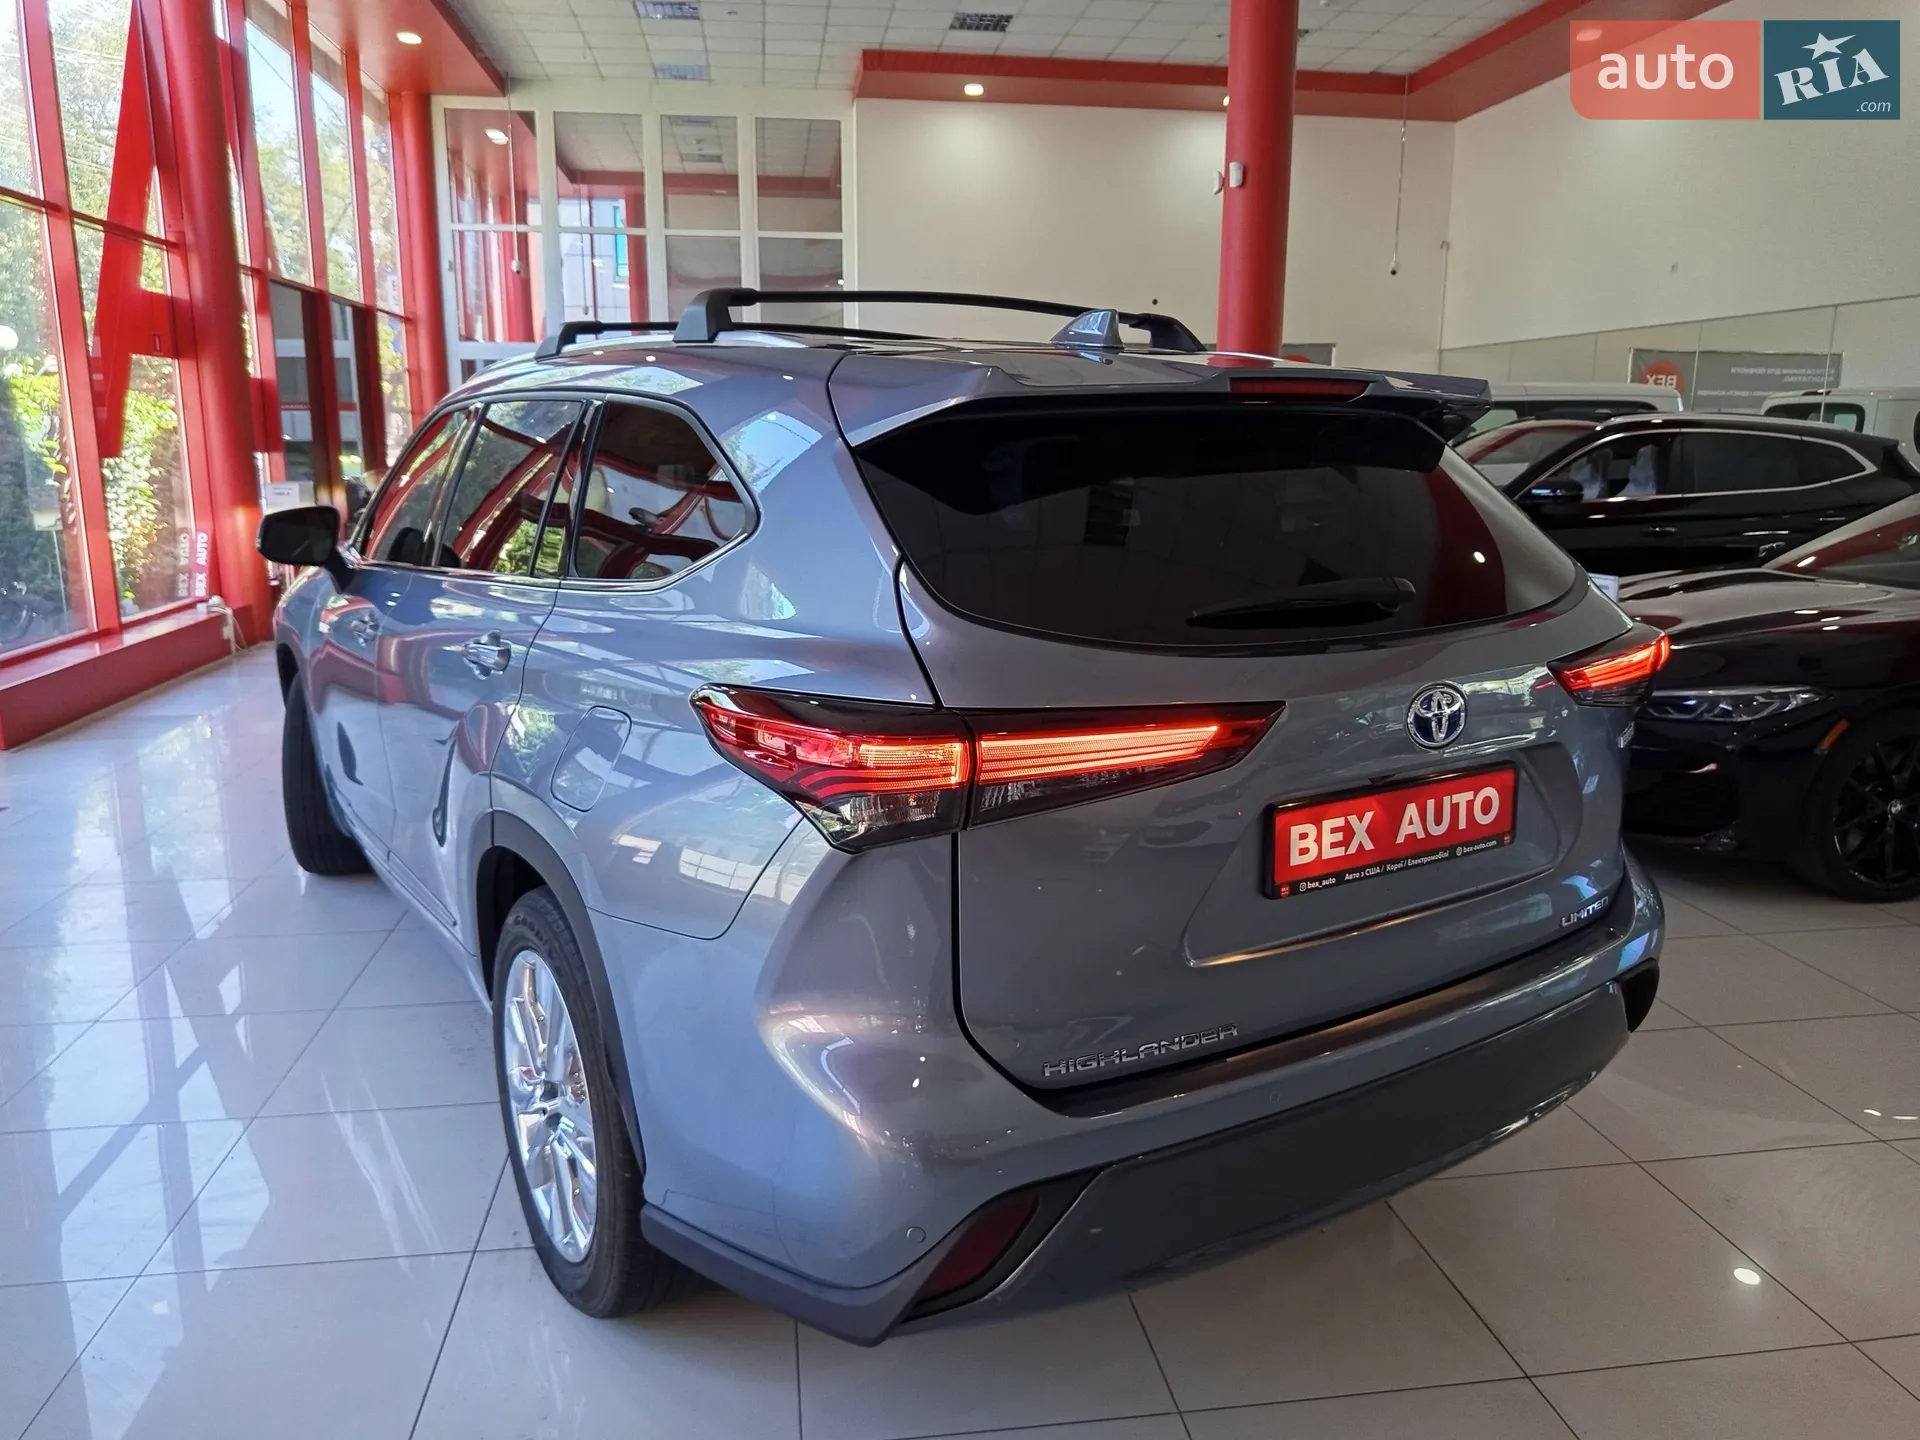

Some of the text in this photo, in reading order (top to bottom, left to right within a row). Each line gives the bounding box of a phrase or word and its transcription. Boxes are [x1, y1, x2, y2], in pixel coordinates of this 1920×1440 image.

[196, 532, 208, 566] AUTO
[1289, 786, 1500, 867] BEX AUTO
[1463, 840, 1497, 853] bex-auto.com
[1307, 877, 1336, 890] bex_auto
[1344, 873, 1360, 881] Авто
[1561, 895, 1609, 928] LIMITED
[1043, 1022, 1239, 1077] HIGHLANDER
